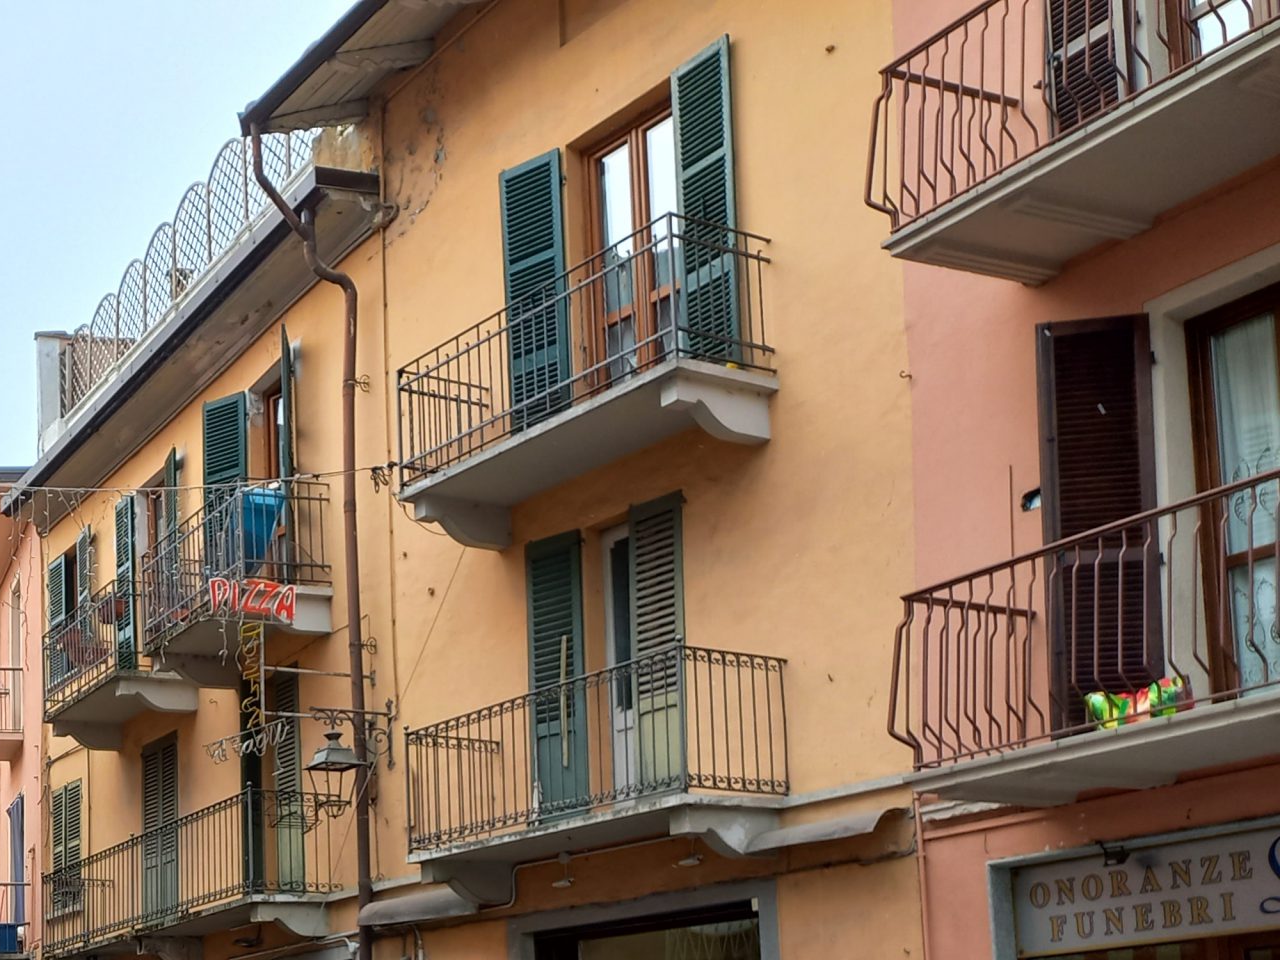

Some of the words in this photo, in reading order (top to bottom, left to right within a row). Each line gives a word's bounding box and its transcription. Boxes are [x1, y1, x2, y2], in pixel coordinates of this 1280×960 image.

[209, 578, 297, 623] PIZZA
[1029, 850, 1254, 909] ONORANZE
[1049, 891, 1236, 943] FUNEBRI
